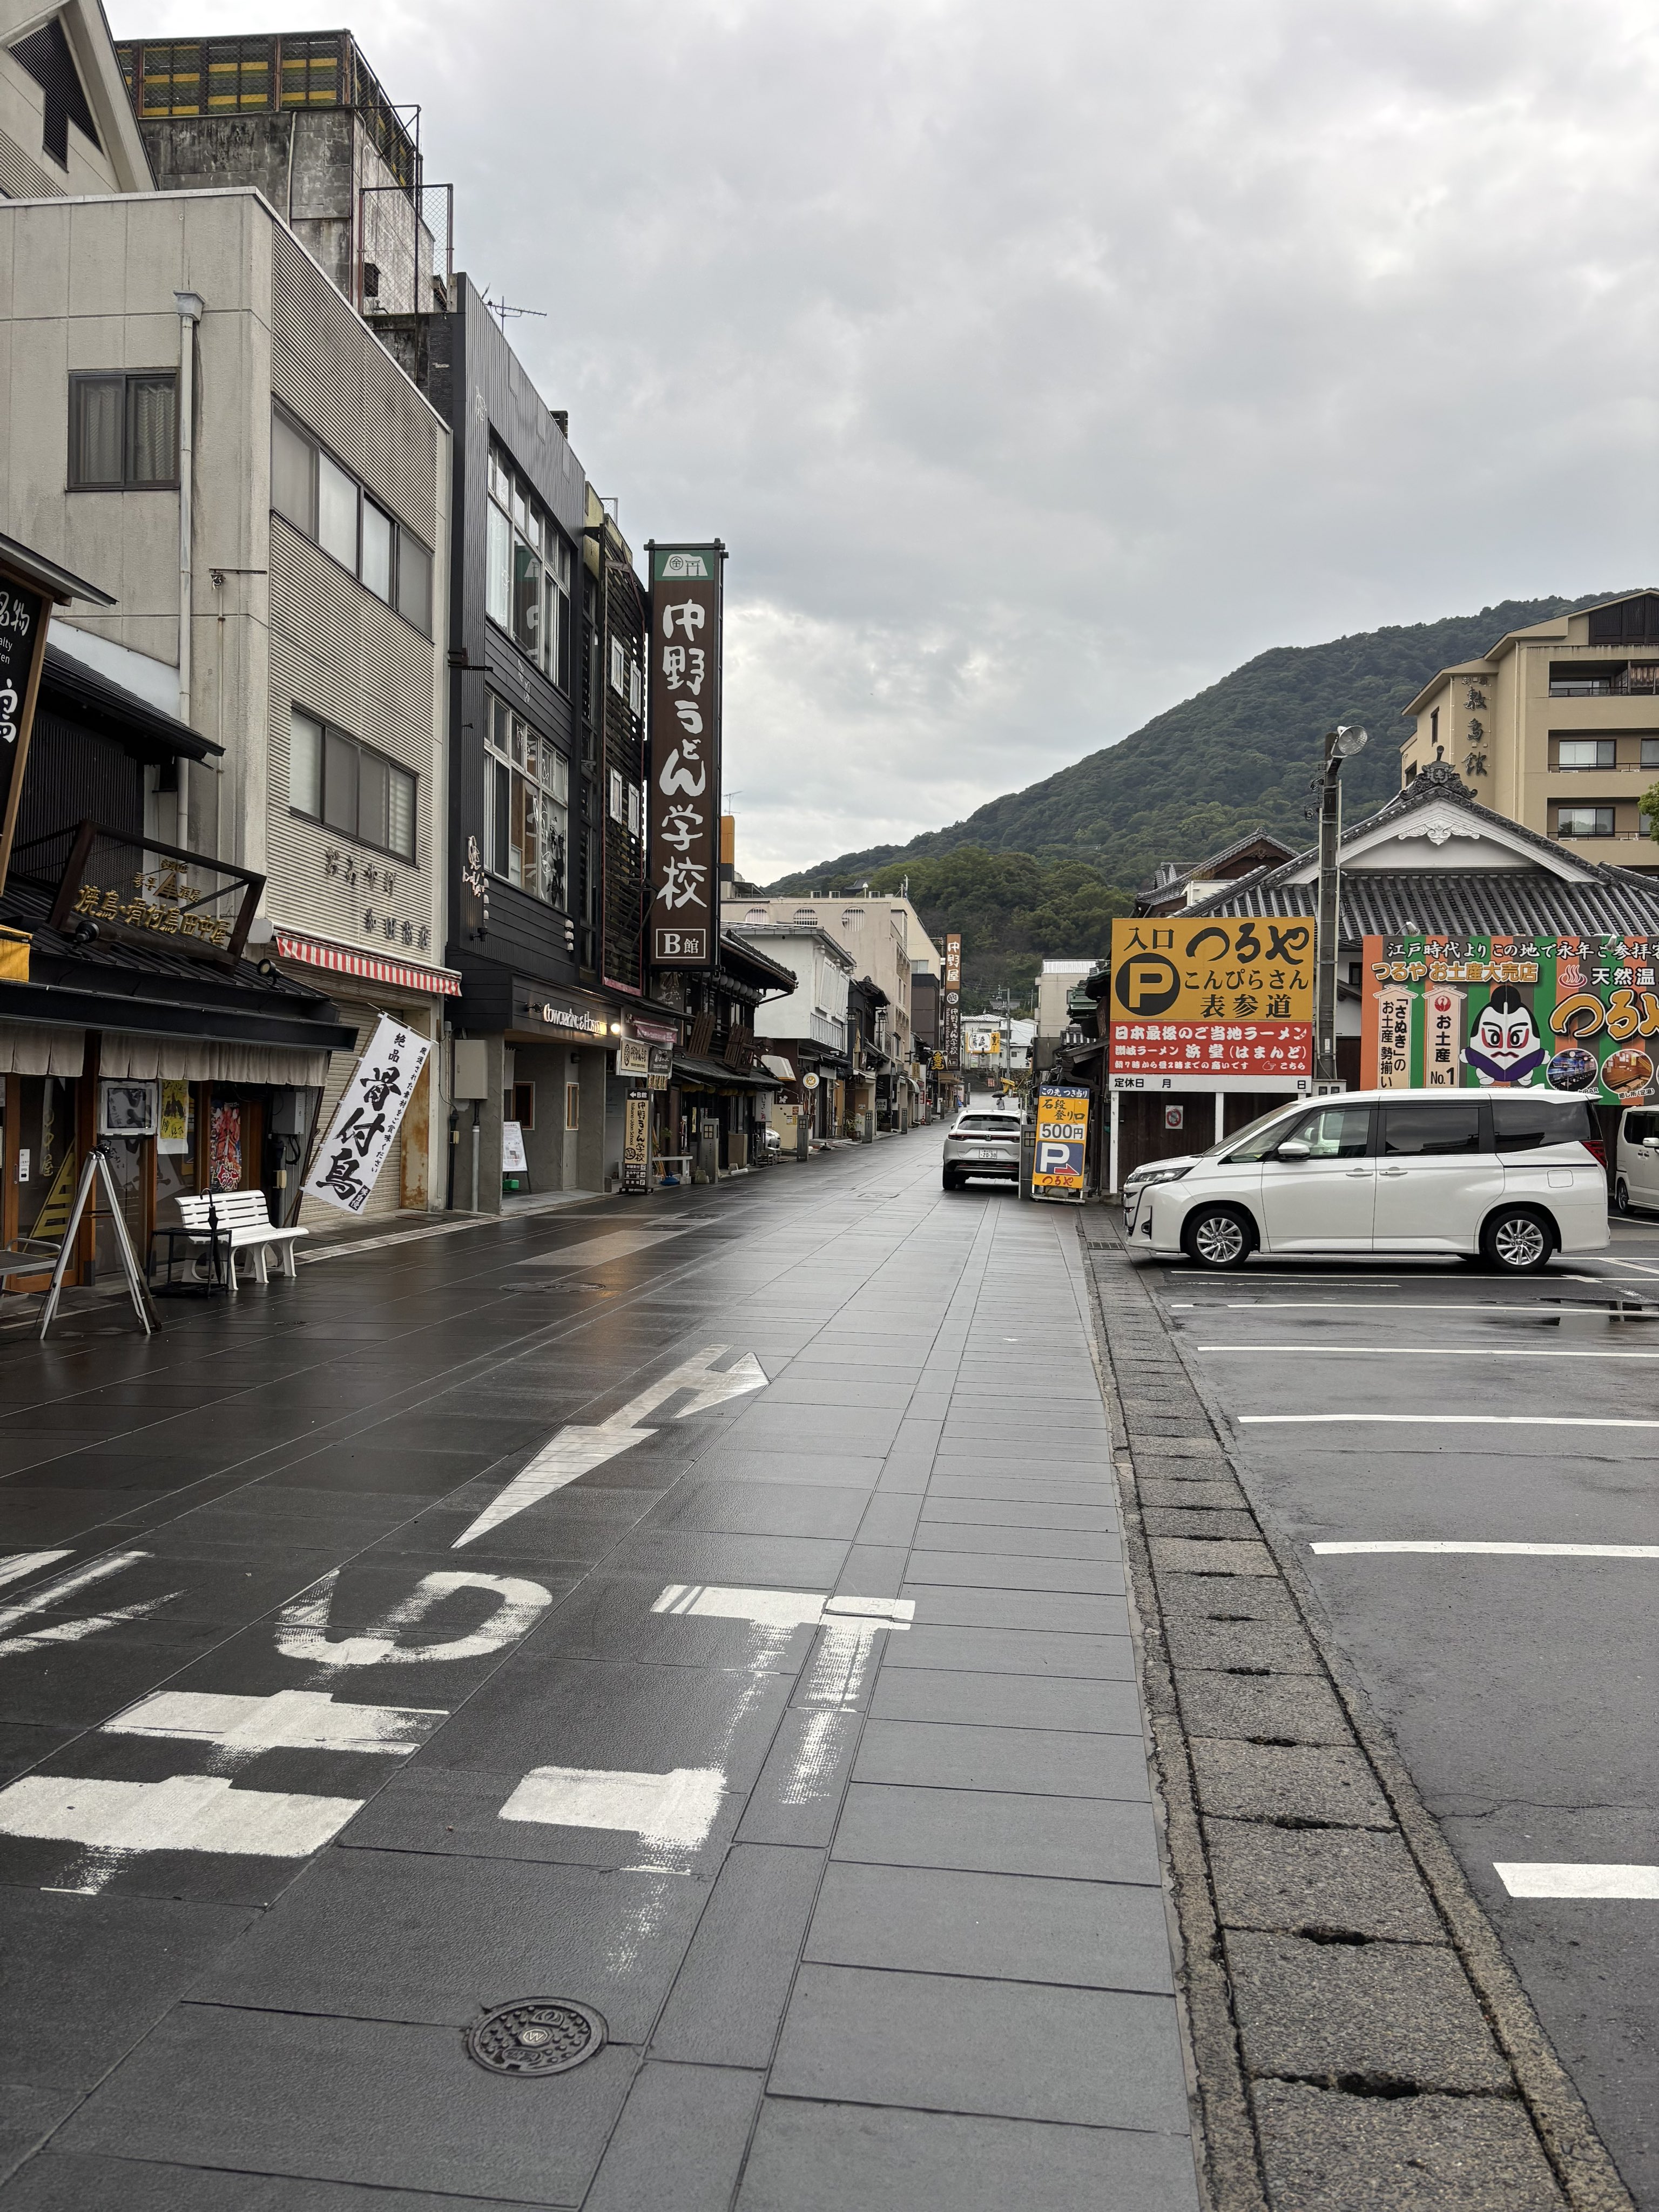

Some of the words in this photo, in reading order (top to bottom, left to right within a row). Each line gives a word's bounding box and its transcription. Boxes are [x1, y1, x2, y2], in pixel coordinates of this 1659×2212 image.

[656, 599, 707, 911] 中野うどん学校
[663, 933, 699, 954] B館
[1123, 927, 1174, 951] 入口
[1185, 922, 1309, 965] つるや
[1387, 941, 1486, 959] 江戸時代より
[947, 941, 960, 981] 中野屋
[1372, 961, 1427, 981] つるや
[1431, 961, 1539, 983] お土産大売店
[1128, 962, 1174, 1008] P
[1184, 968, 1309, 990] こんぴらさん
[1200, 994, 1292, 1019] 表参道
[1115, 1025, 1307, 1041] 日本最後のご当地ラーメン
[1381, 1001, 1394, 1043] お土産
[1393, 999, 1408, 1072] 「さぬき」の
[1435, 1015, 1452, 1062] お土産
[388, 1033, 407, 1063] 絶品
[1115, 1044, 1179, 1056] 讃岐ラーメン
[1280, 1061, 1306, 1070] こちら
[1380, 1047, 1393, 1088] 勢揃い
[1431, 1067, 1454, 1085] No.1
[1041, 1088, 1062, 1097] この先
[1063, 1089, 1088, 1098] つき当り
[1114, 1078, 1144, 1088] 定休日
[1162, 1078, 1171, 1088] 月
[1297, 1080, 1306, 1089] 日
[1042, 1099, 1067, 1110] 石段
[1054, 1110, 1085, 1121] 登り口
[315, 1066, 402, 1201] 骨付鳥
[1042, 1124, 1083, 1139] 500円
[1040, 1143, 1070, 1172] P
[1042, 1176, 1074, 1186] つるや
